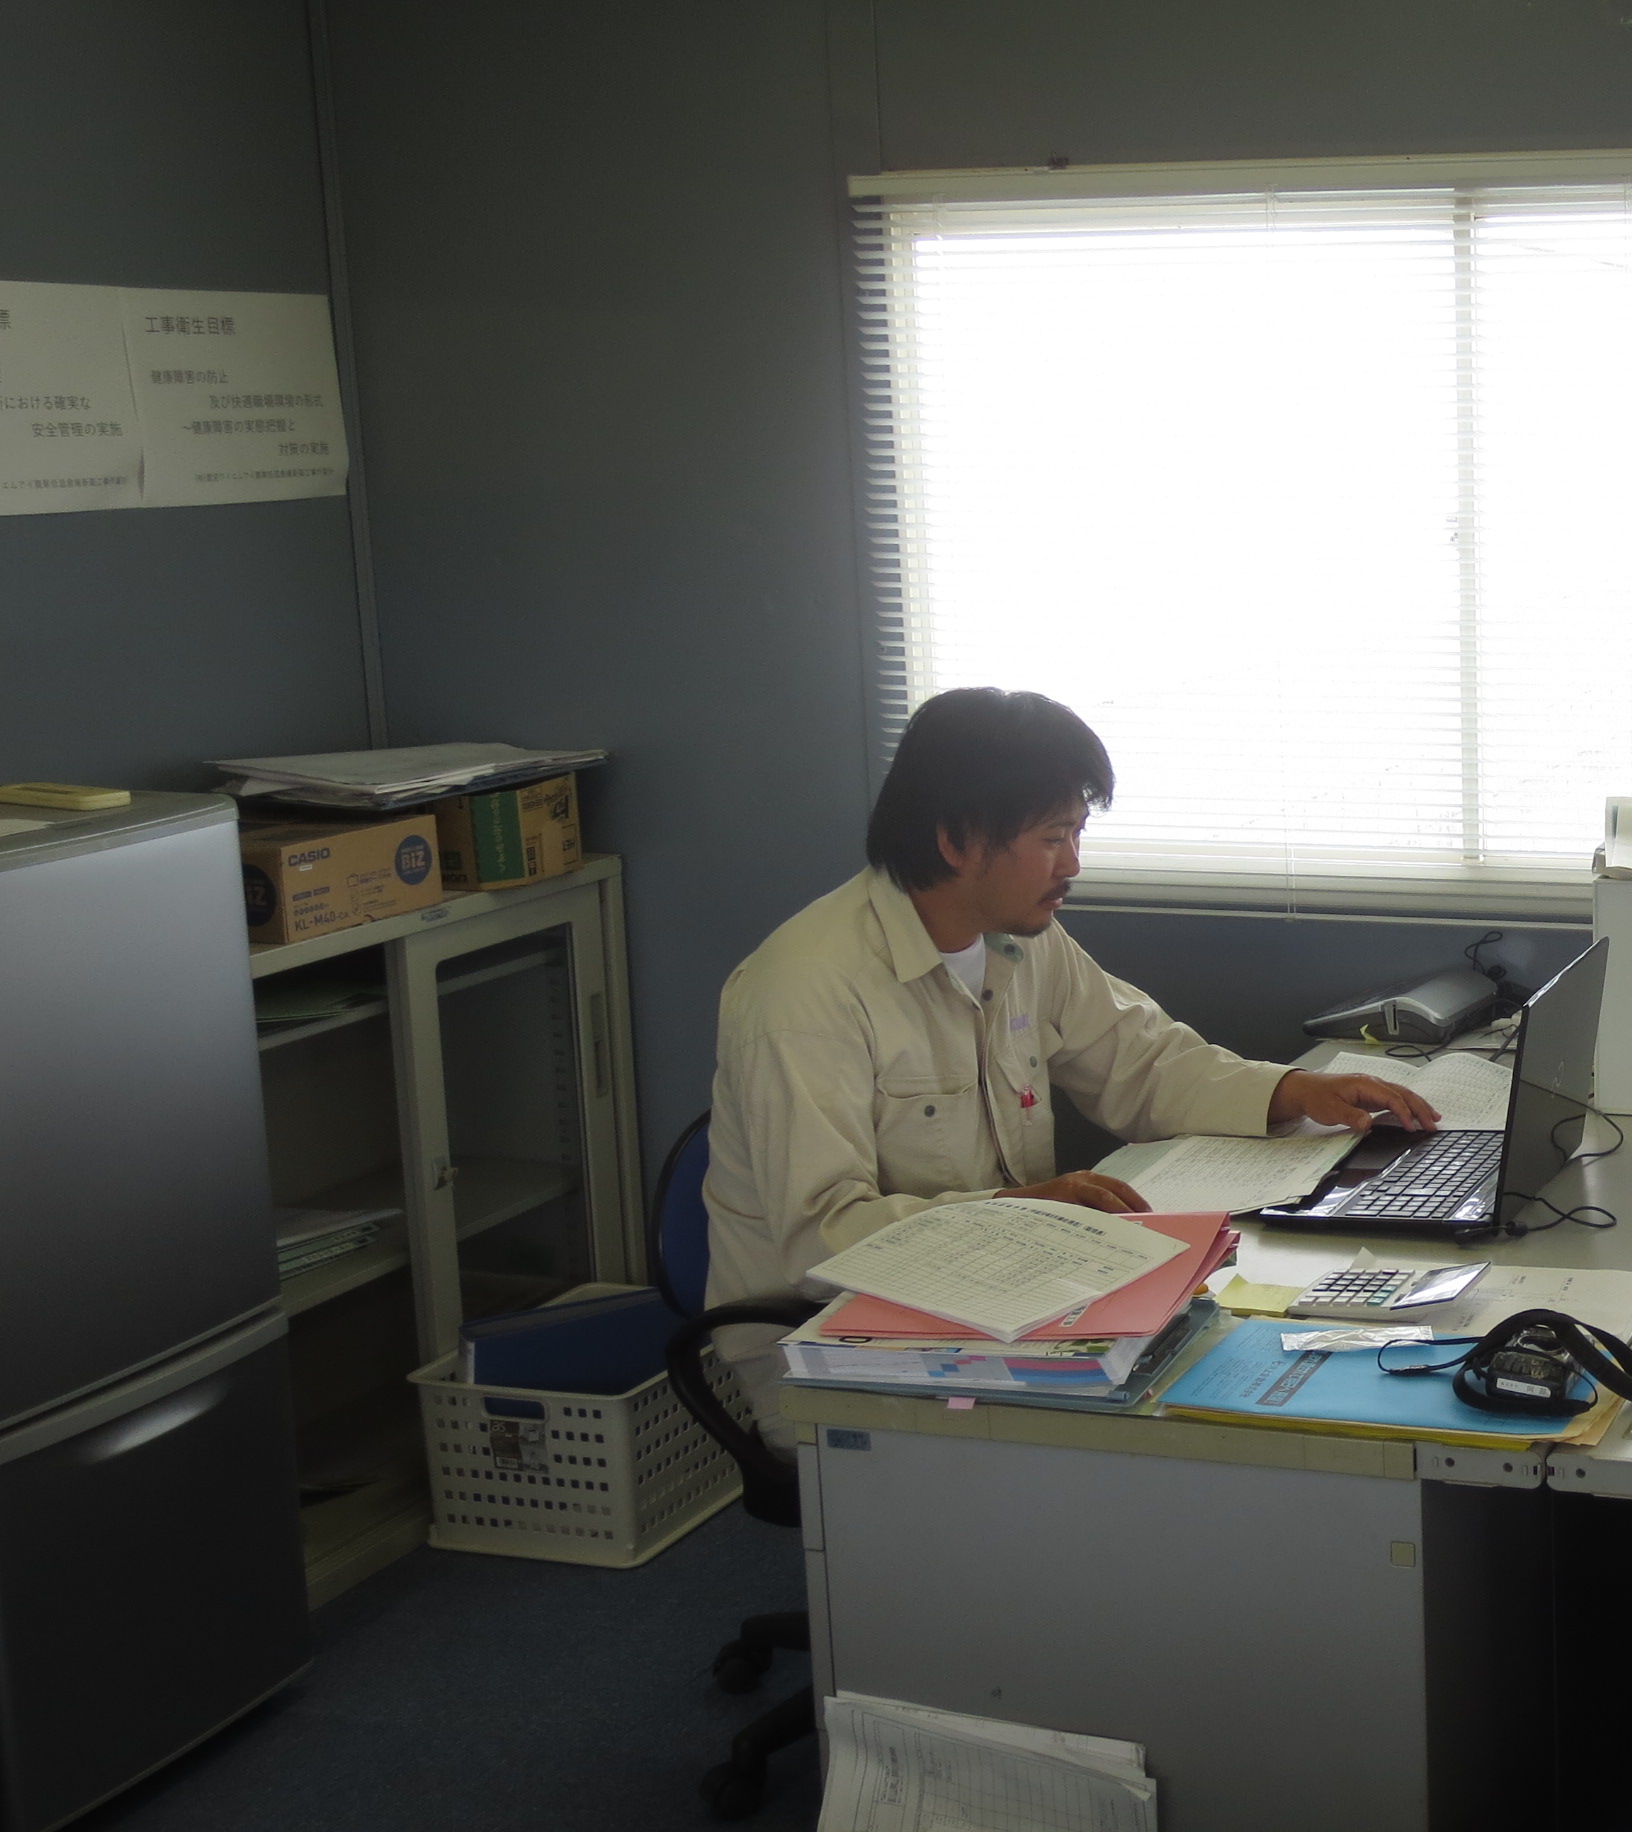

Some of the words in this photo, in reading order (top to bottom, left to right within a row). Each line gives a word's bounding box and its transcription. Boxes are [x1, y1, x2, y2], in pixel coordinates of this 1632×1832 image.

[145, 315, 236, 336] 工事衛生目標
[0, 395, 92, 411] における確実な
[31, 422, 123, 439] 安全管理の実施
[288, 847, 331, 867] CASIO
